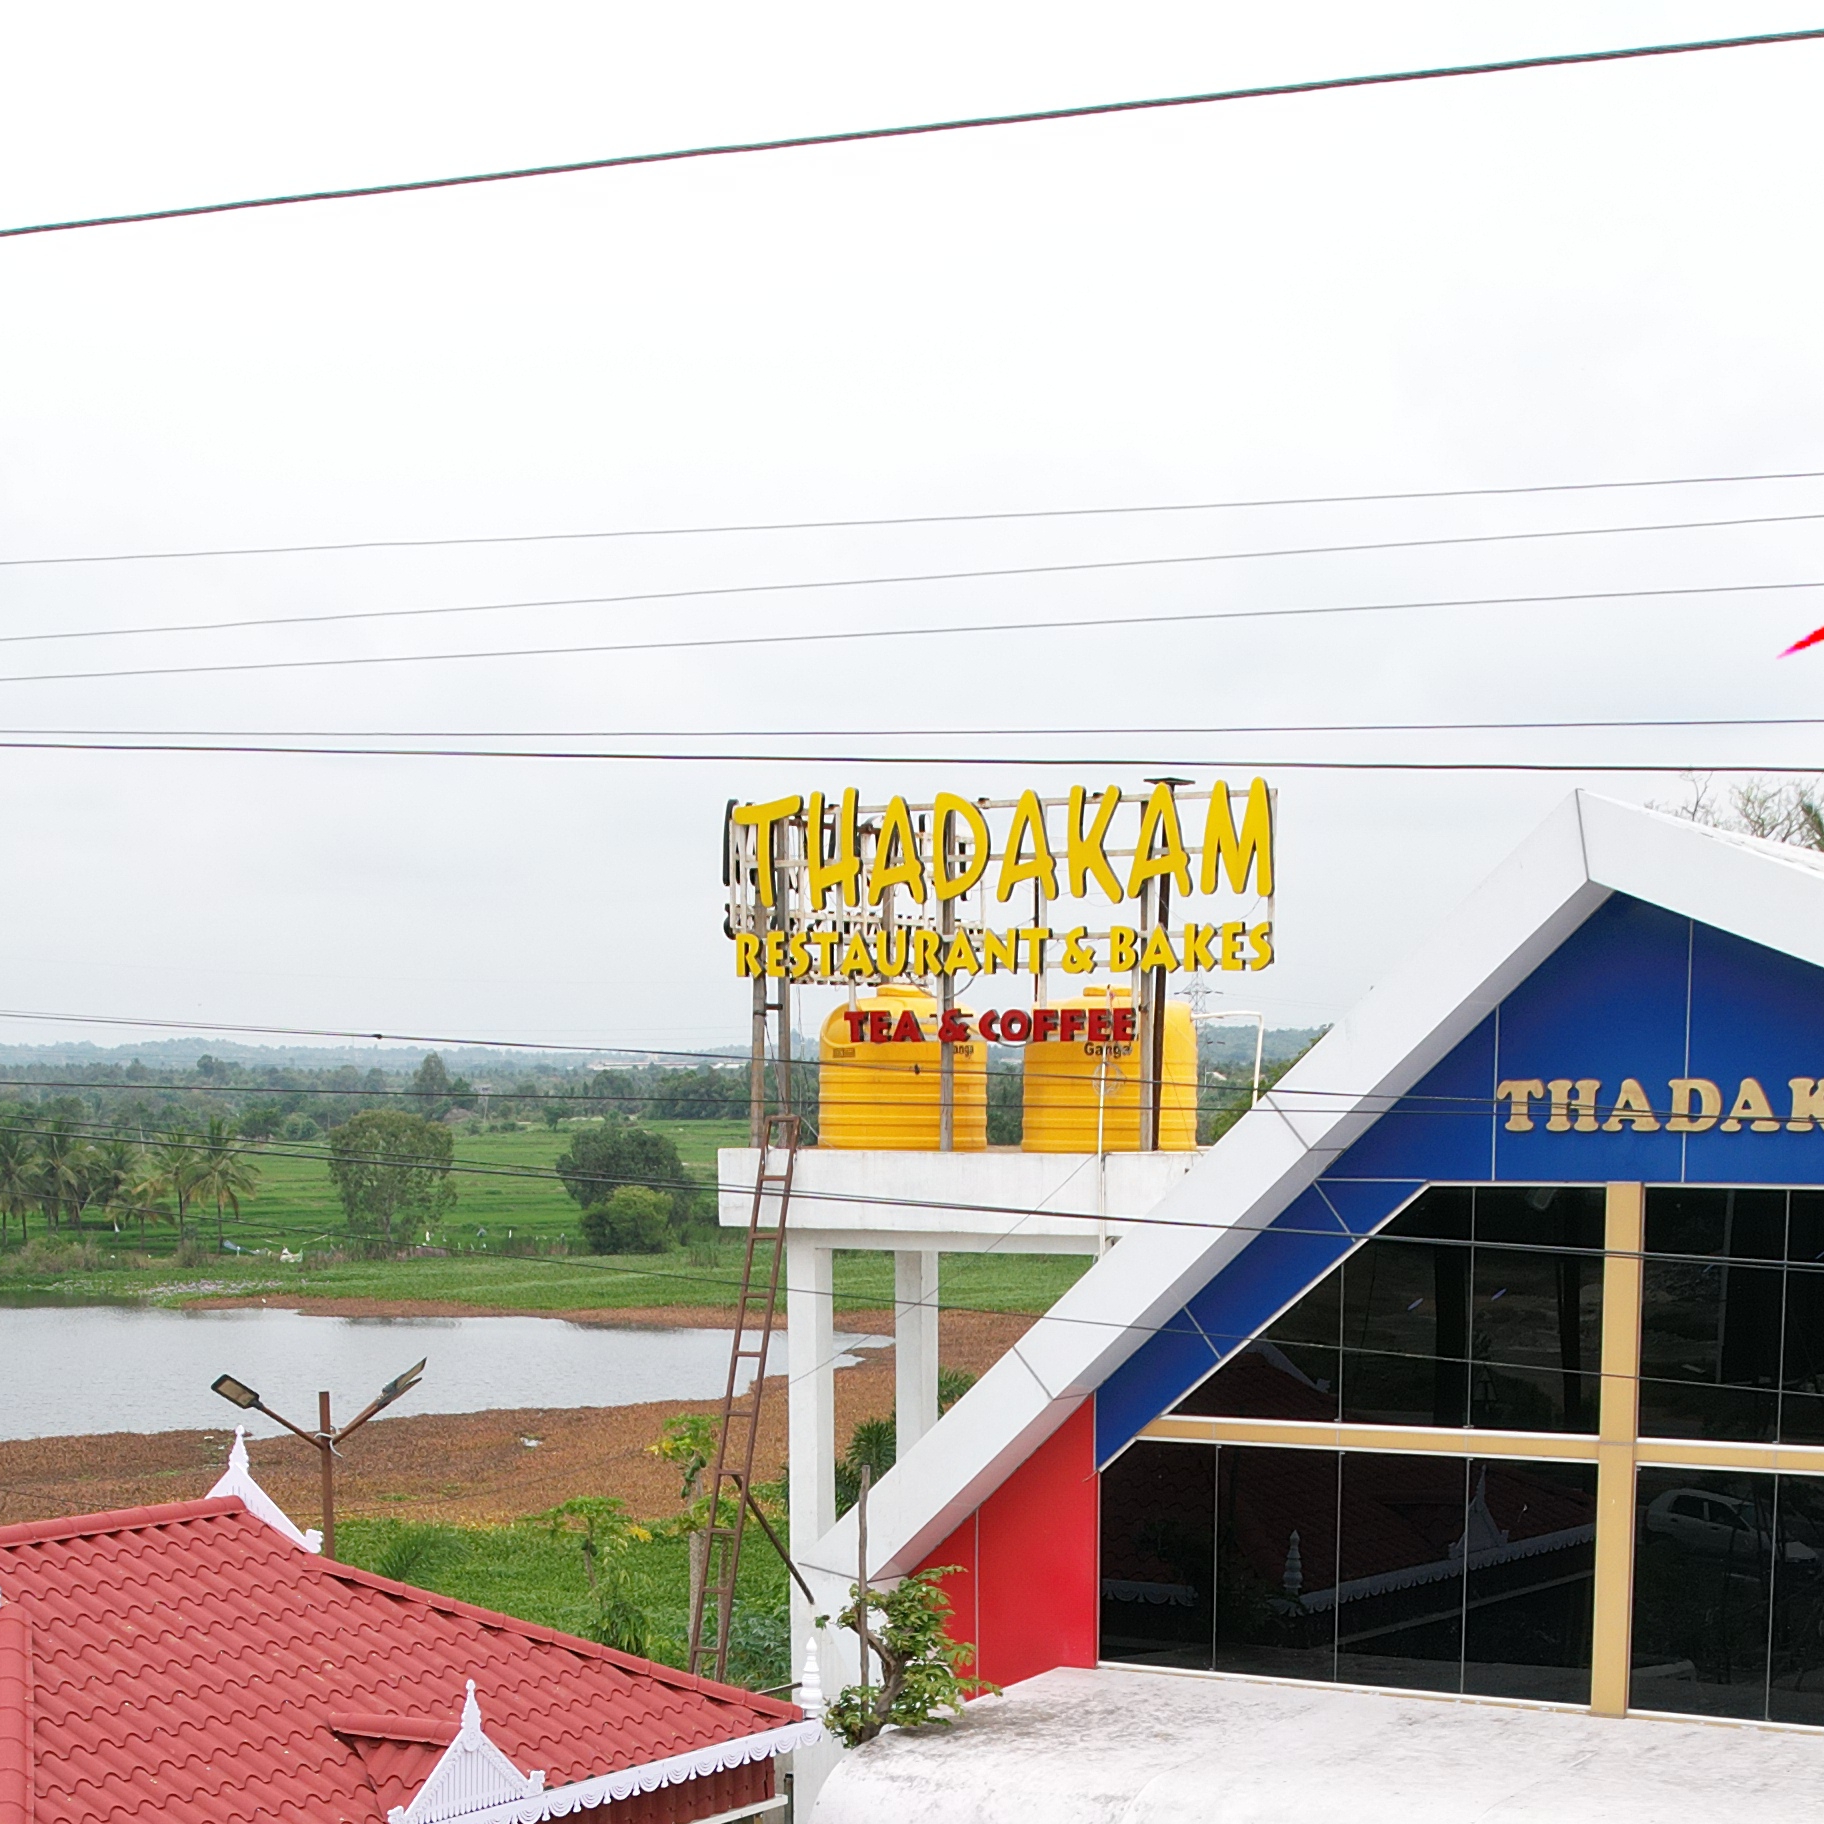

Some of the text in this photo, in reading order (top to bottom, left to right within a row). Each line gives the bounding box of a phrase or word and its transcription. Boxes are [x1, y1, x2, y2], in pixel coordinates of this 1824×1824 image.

[734, 777, 1275, 911] THADAKAM
[736, 921, 1273, 979] RESTAURANT & BAKES
[844, 1008, 1134, 1043] TEA & COFFEE
